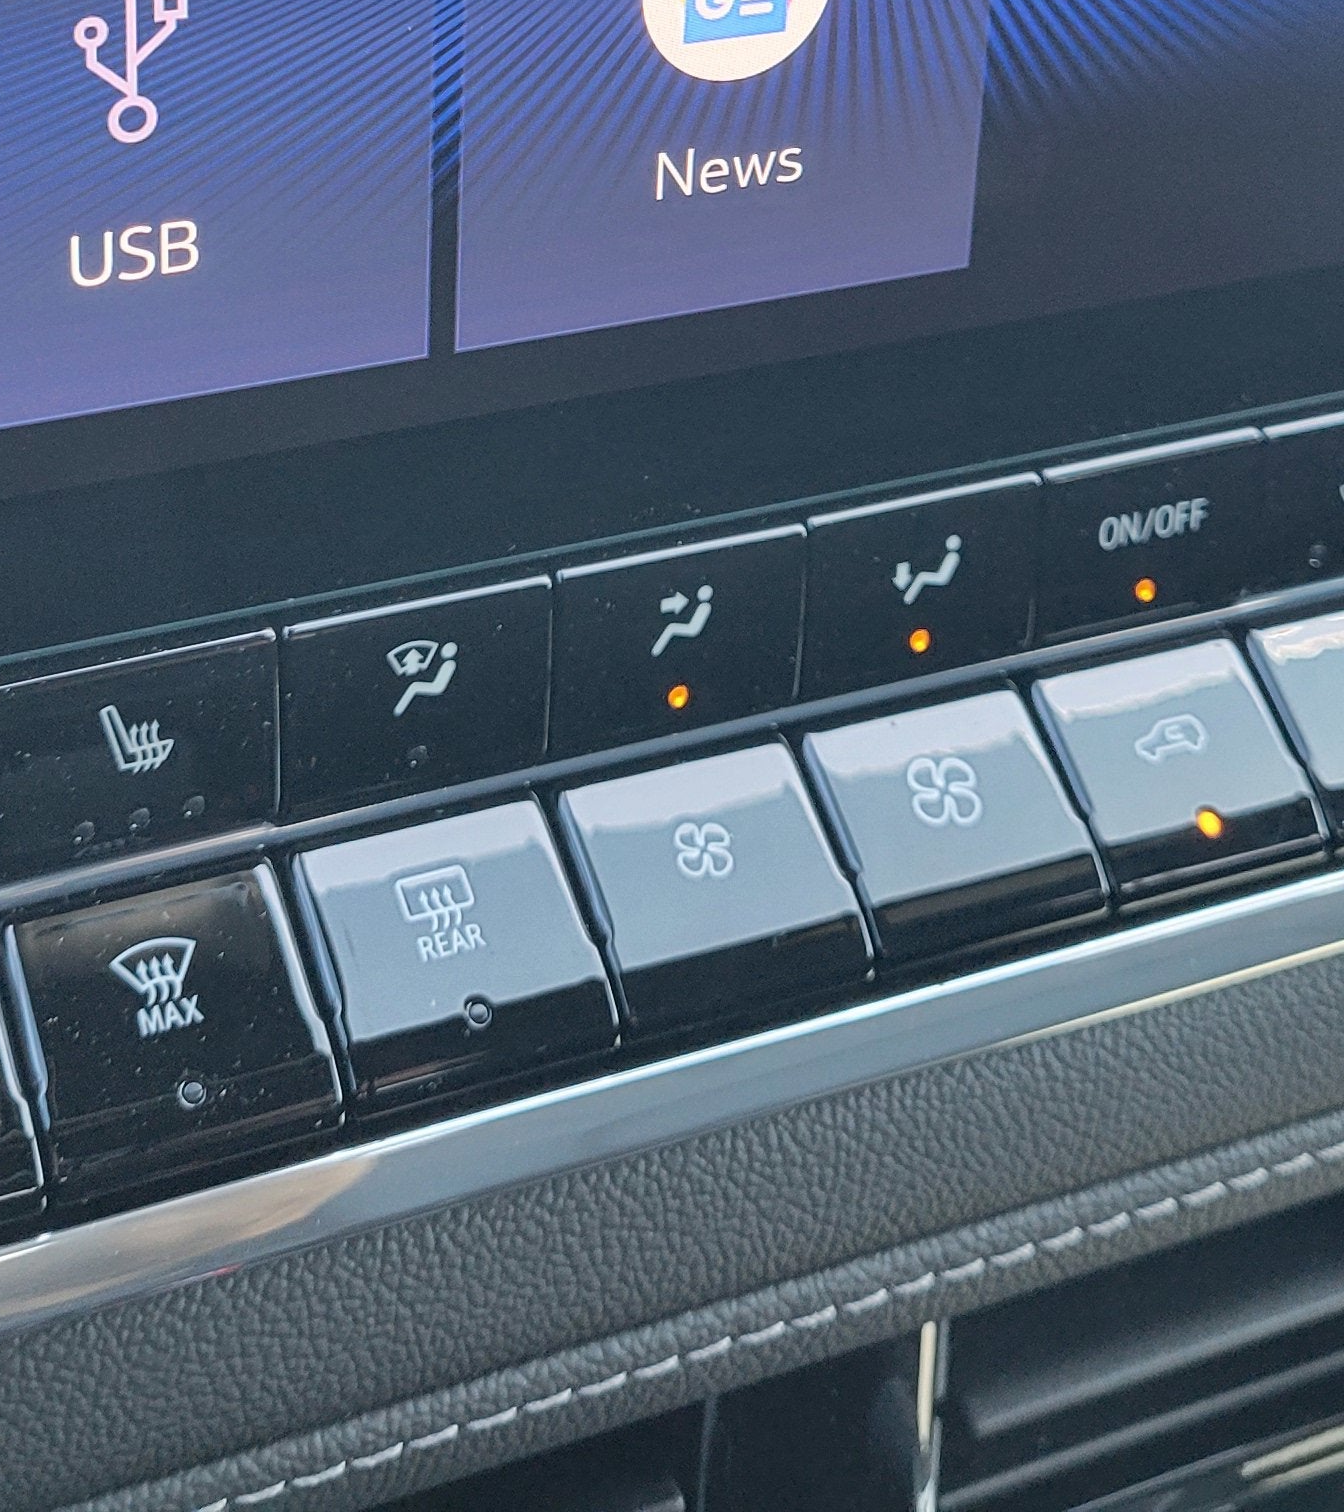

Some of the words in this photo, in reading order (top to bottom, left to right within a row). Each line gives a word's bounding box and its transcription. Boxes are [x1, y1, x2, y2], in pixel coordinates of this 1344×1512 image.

[654, 144, 805, 201] News
[68, 220, 200, 287] USB
[1098, 497, 1210, 552] ON/OFF
[417, 924, 487, 963] REAR
[137, 993, 205, 1038] MAX
